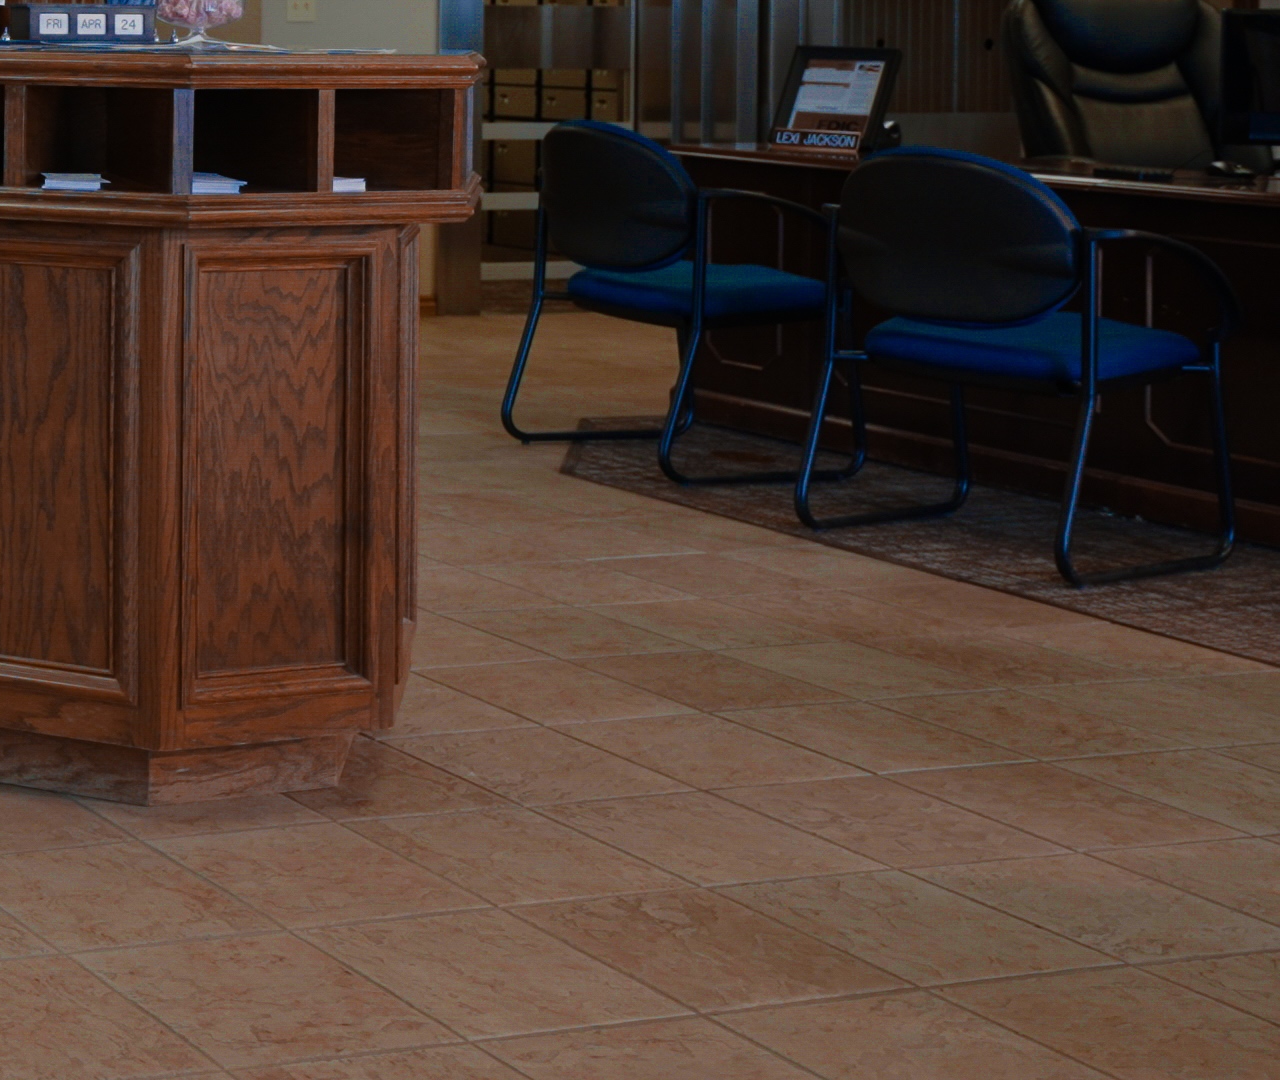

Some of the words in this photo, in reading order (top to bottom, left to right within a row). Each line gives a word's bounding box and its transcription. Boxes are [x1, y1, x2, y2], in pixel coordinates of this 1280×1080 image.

[46, 18, 62, 29] FRI
[81, 18, 102, 29] APR
[121, 19, 136, 30] 24
[776, 132, 800, 144] LEXI
[803, 133, 856, 148] JACKSON
